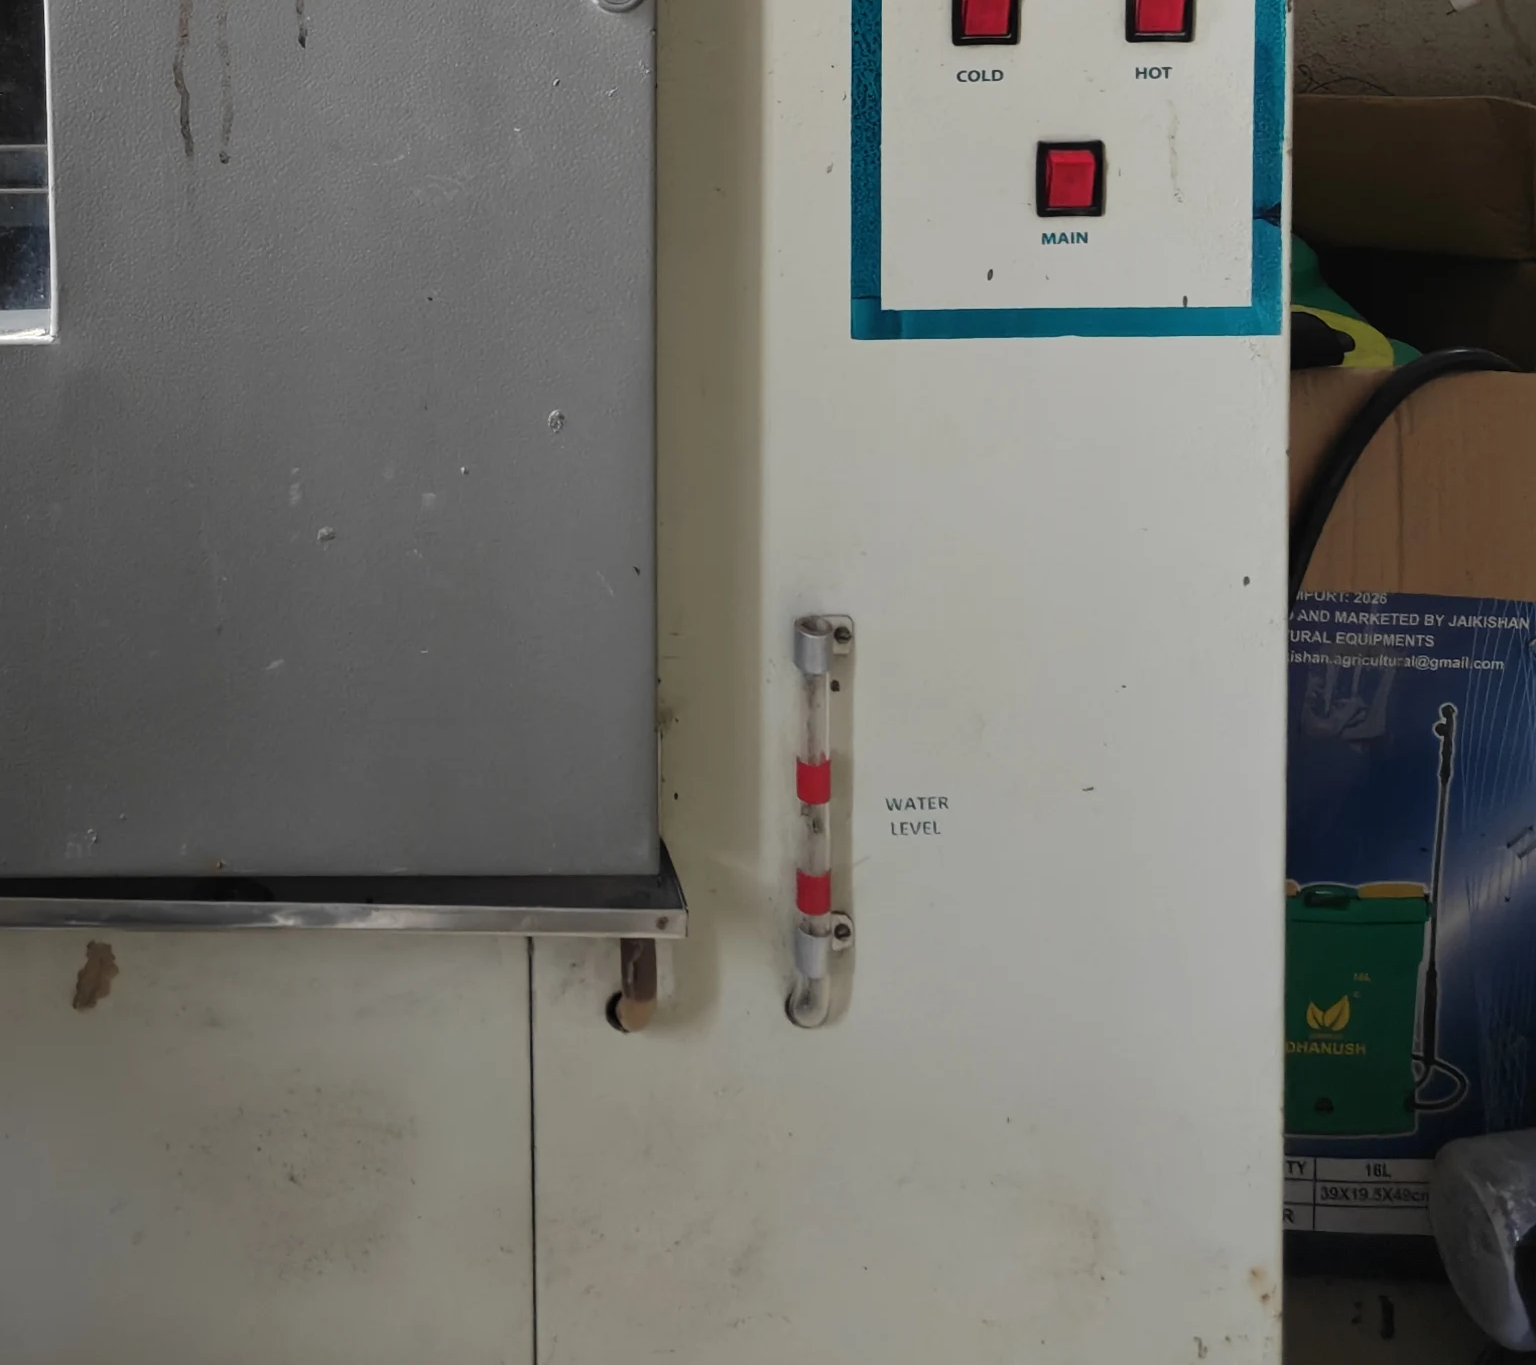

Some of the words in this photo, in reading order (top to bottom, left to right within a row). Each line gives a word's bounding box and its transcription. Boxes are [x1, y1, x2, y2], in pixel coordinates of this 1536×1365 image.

[956, 69, 1005, 84] COLD
[1134, 66, 1173, 81] HOT
[1041, 231, 1090, 246] MAIN
[1354, 592, 1388, 605] 2026
[1297, 609, 1331, 623] AND
[1335, 611, 1420, 627] MARKETED
[1424, 614, 1445, 627] BY
[1448, 615, 1530, 630] JAIKISHAN
[1287, 630, 1332, 644] URAL
[1335, 632, 1435, 648] EQUIPMENTS
[1287, 650, 1505, 671] ishan.agricultural@gmail.com
[885, 795, 950, 812] WATER
[890, 820, 942, 836] LEVEL
[1285, 1041, 1366, 1055] DHANUSH
